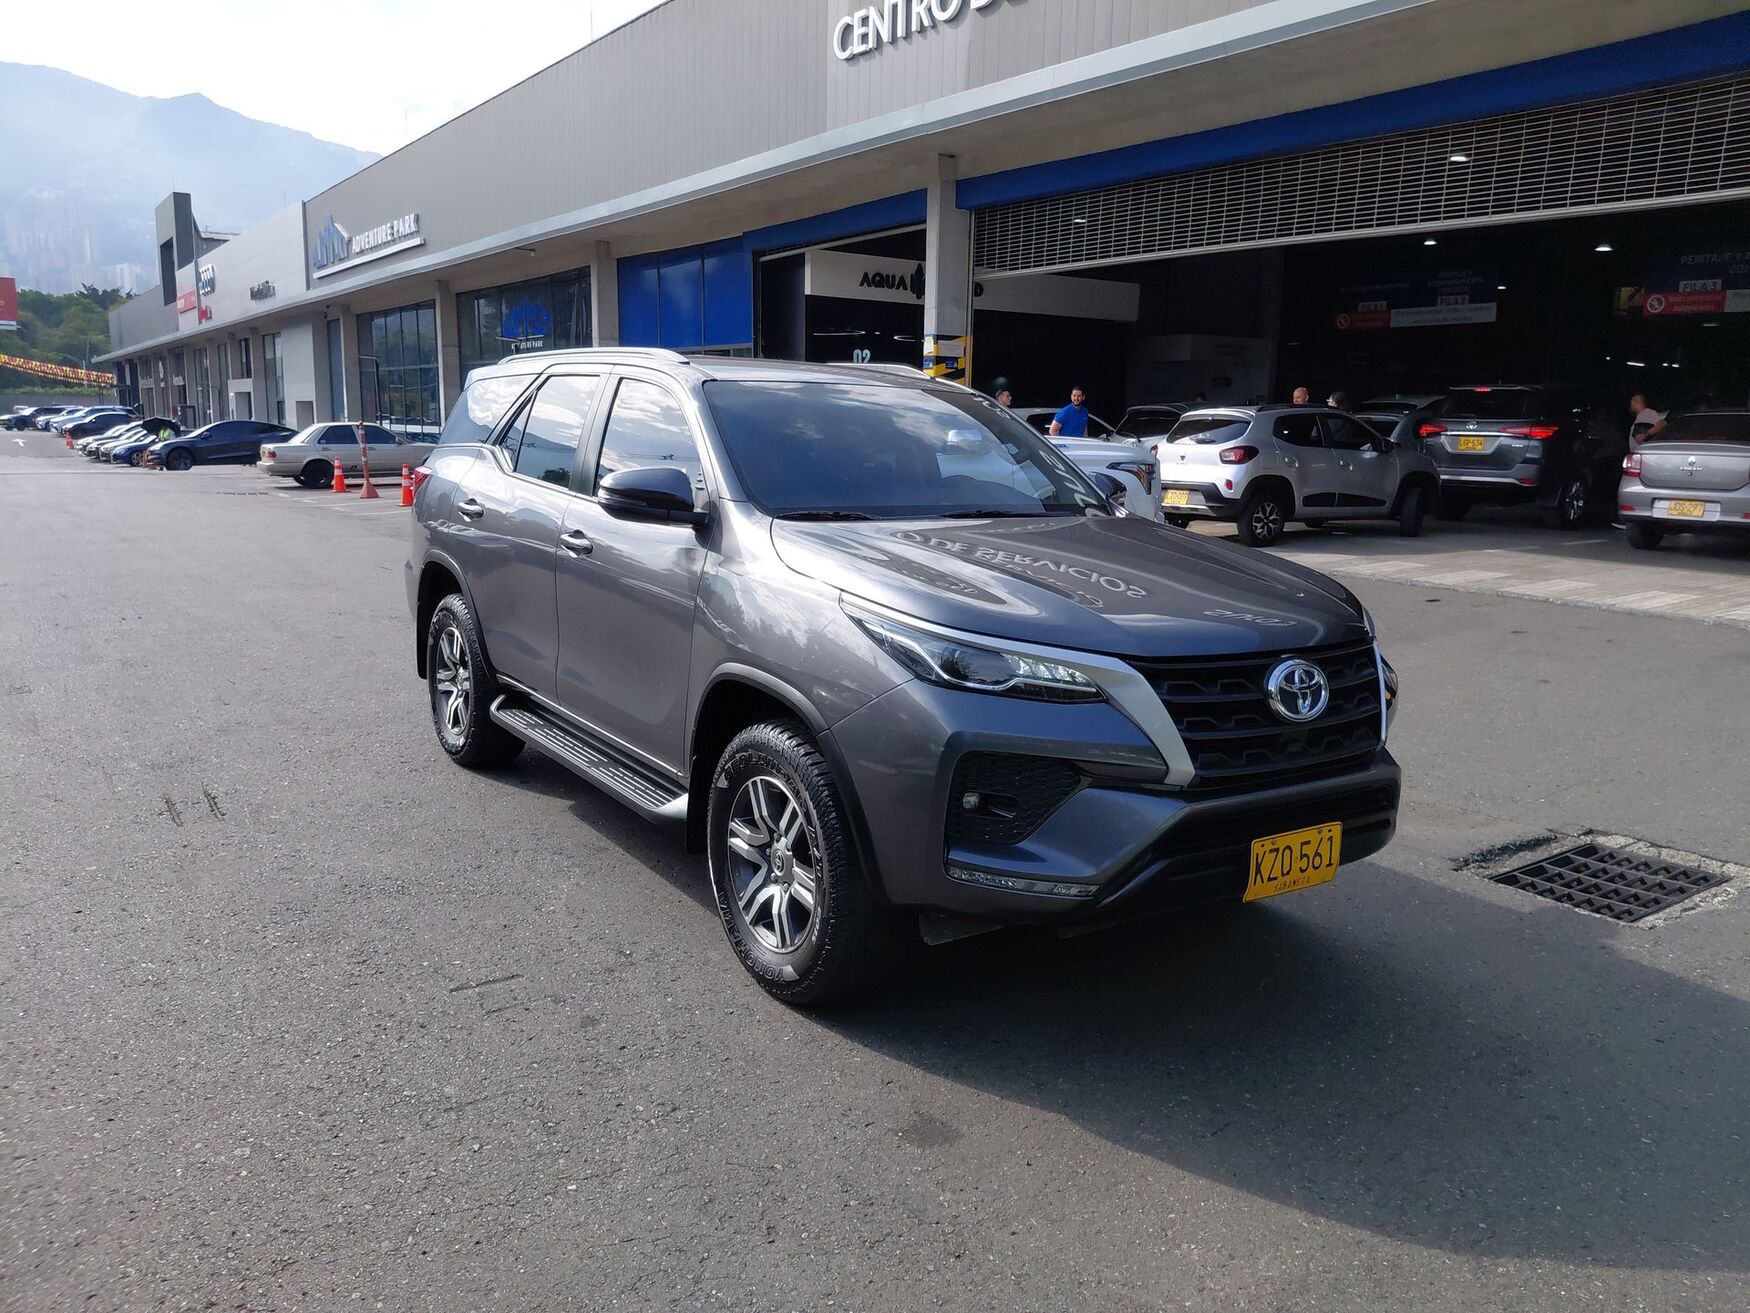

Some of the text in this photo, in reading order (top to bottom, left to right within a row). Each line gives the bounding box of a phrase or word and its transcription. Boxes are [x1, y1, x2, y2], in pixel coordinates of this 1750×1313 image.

[352, 212, 418, 255] ADVENTURE PARK
[859, 272, 908, 291] AQUA
[852, 348, 871, 363] 02
[1298, 835, 1334, 874] 561
